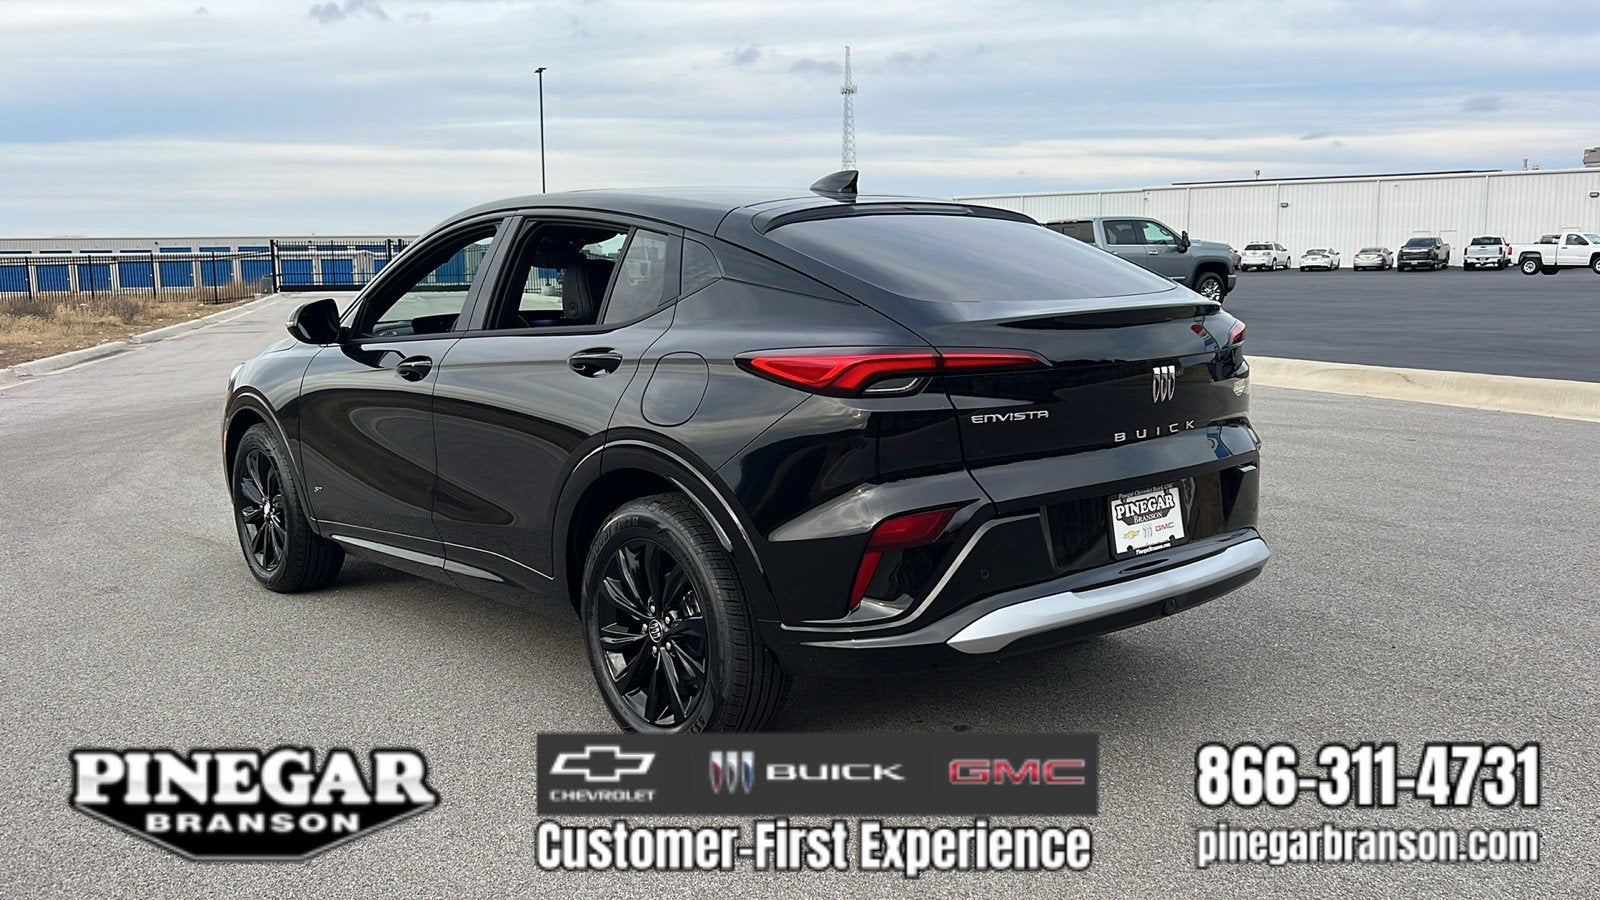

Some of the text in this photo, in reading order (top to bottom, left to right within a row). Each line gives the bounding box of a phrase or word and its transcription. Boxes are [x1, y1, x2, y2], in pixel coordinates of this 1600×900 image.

[971, 410, 1049, 424] ENVISTA
[1114, 419, 1195, 443] BUICK
[1116, 494, 1175, 520] PINEGAR
[1155, 521, 1175, 532] GMC
